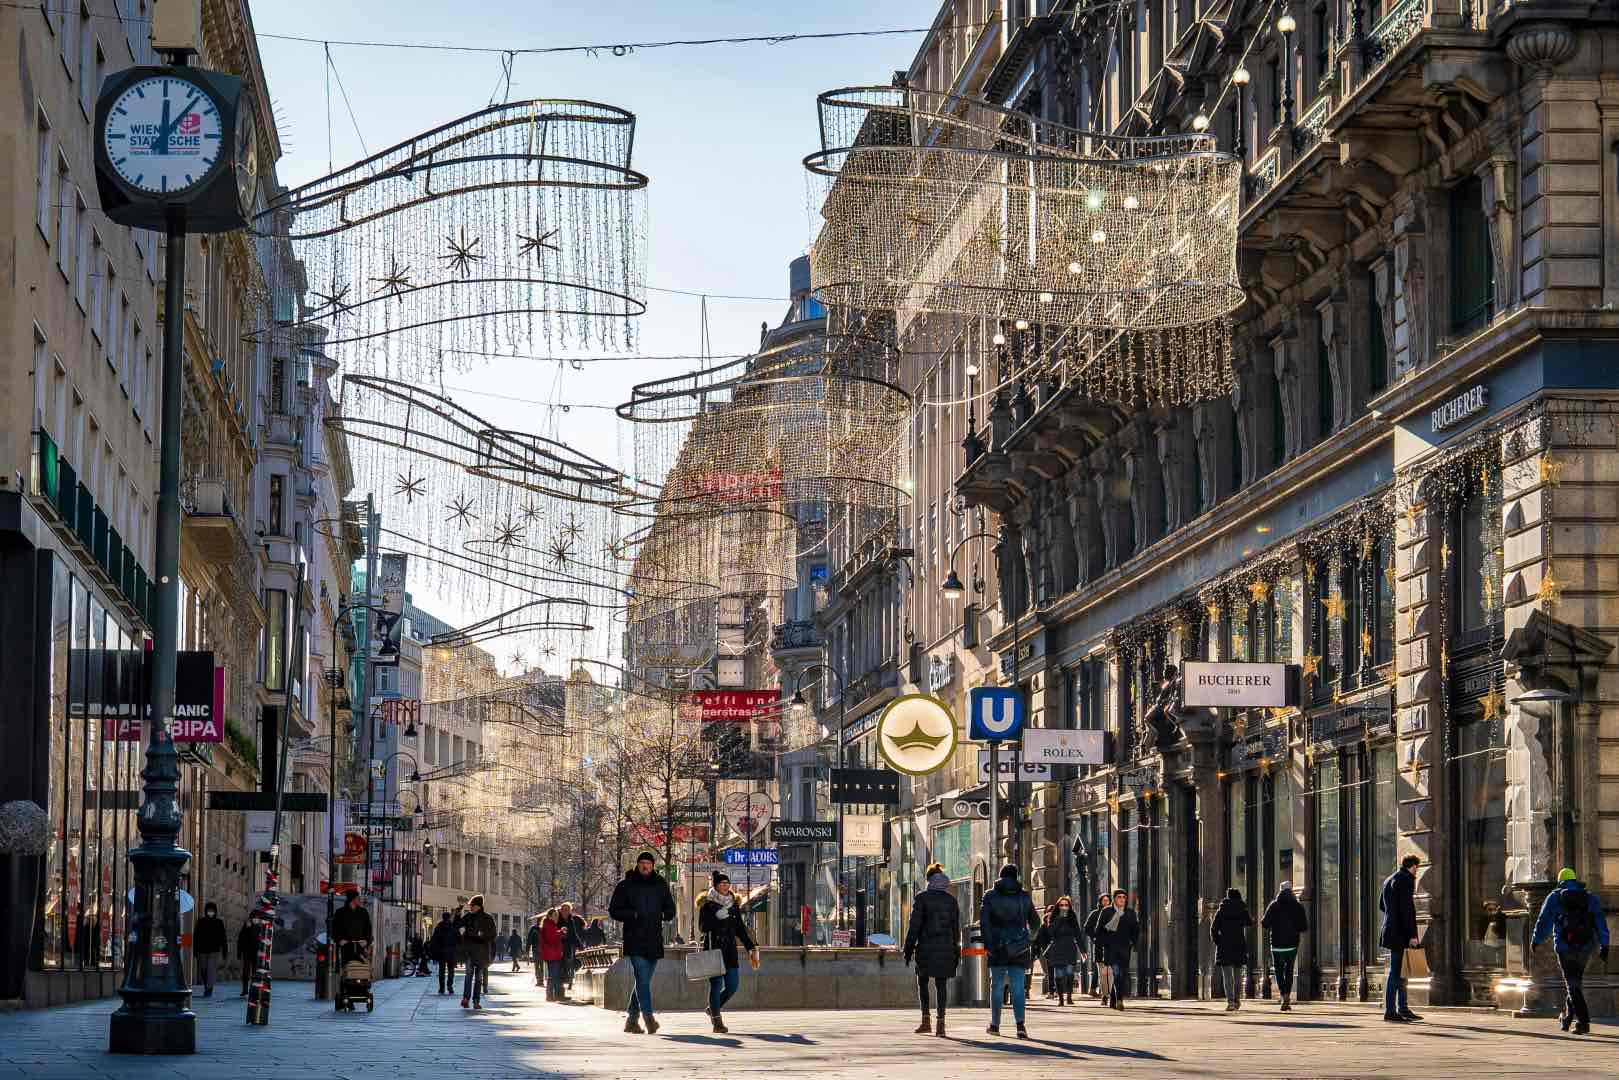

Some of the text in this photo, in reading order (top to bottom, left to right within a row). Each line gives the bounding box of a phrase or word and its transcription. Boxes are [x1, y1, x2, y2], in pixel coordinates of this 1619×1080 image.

[1431, 385, 1483, 432] BUCHERER
[1199, 675, 1272, 686] BUCHERER
[982, 698, 1014, 732] U
[172, 720, 218, 737] BIPA
[1043, 748, 1083, 758] ROLEX
[774, 826, 832, 838] SWAROVSKI
[747, 850, 778, 863] ACOBS
